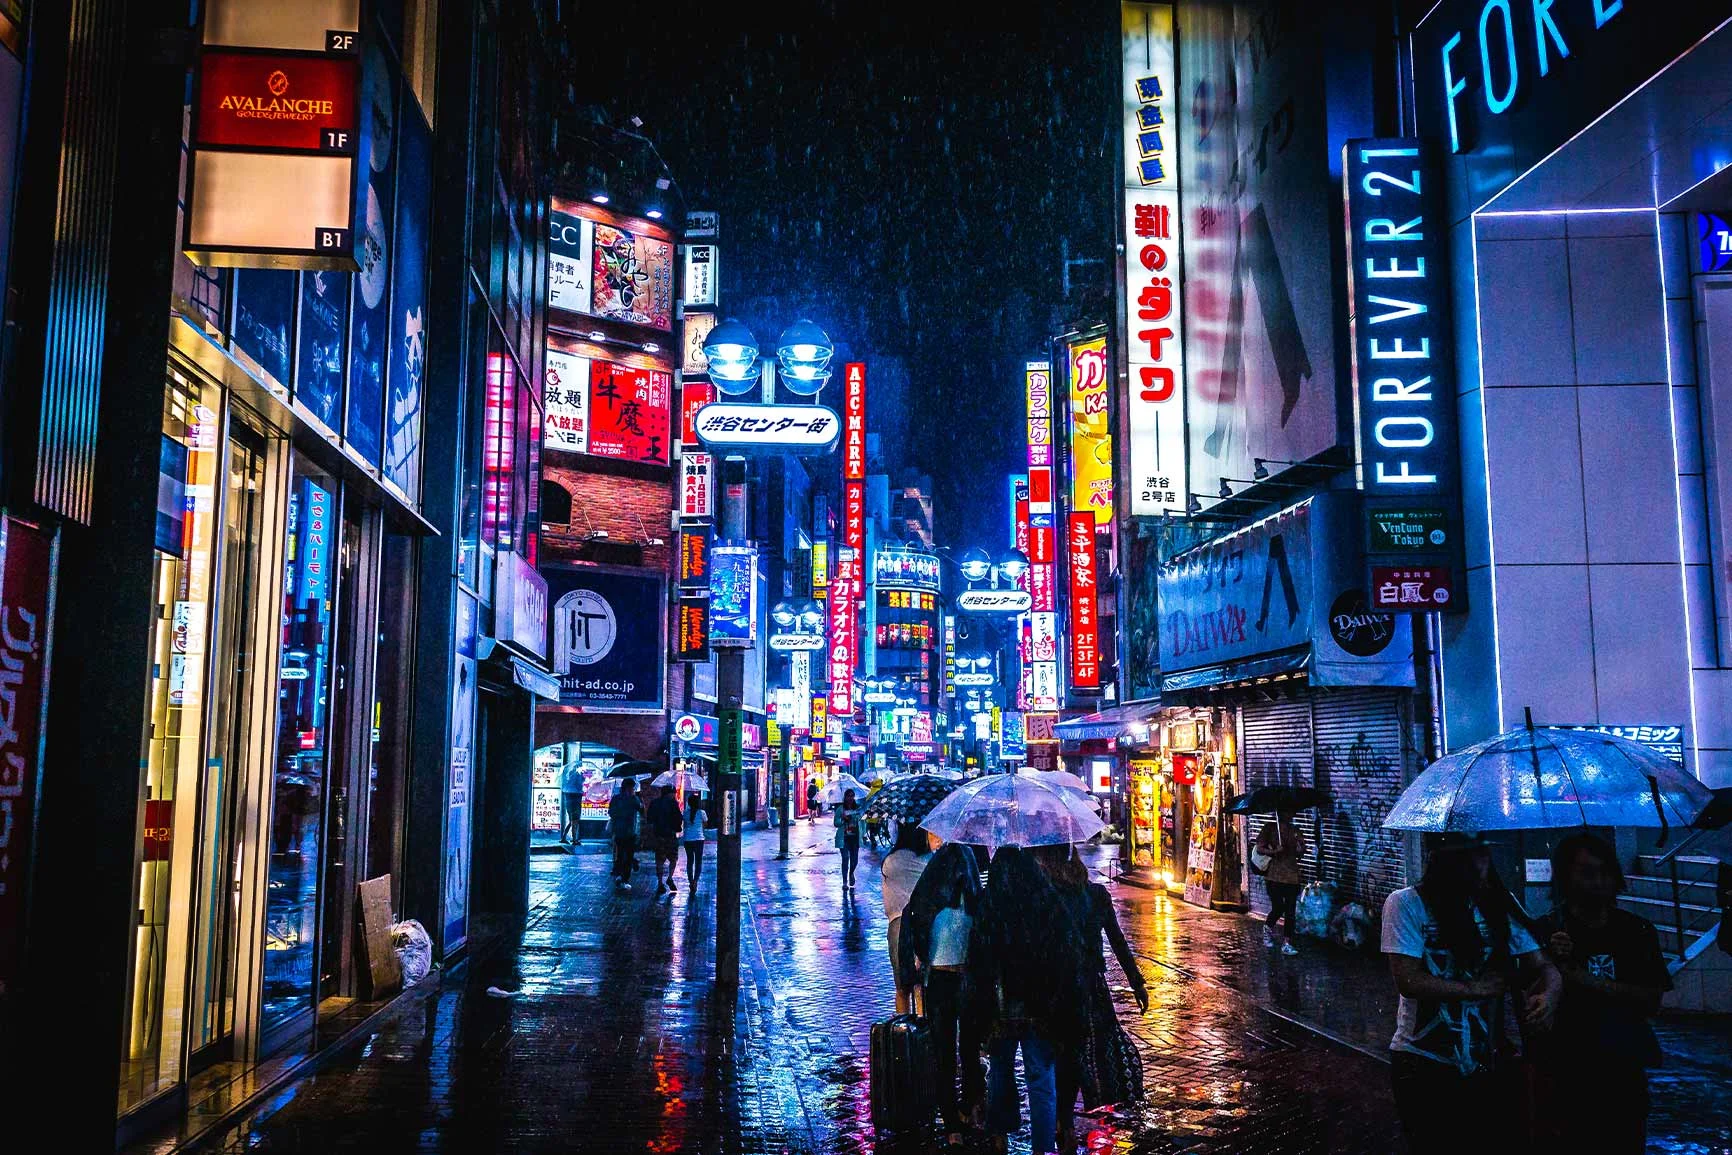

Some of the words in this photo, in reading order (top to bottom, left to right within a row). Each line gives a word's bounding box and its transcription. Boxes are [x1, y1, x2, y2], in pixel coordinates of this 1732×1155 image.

[333, 36, 353, 50] 2F
[1442, 0, 1624, 154] FOR
[220, 96, 333, 115] AVALANCHE
[328, 133, 347, 148] 1F
[1361, 147, 1422, 196] 21
[322, 233, 342, 248] B1
[1134, 203, 1175, 404] 靴のダイワ
[1365, 215, 1437, 484] FOREVER
[1030, 374, 1047, 442] カラオケ
[701, 416, 832, 433] 渋谷センター街
[1146, 476, 1169, 489] 渋谷
[1141, 491, 1175, 503] 2号店
[962, 596, 1029, 606] 渋谷センター街
[1077, 633, 1093, 644] 2F
[1078, 651, 1094, 662] 3F
[1079, 668, 1095, 679] 4F
